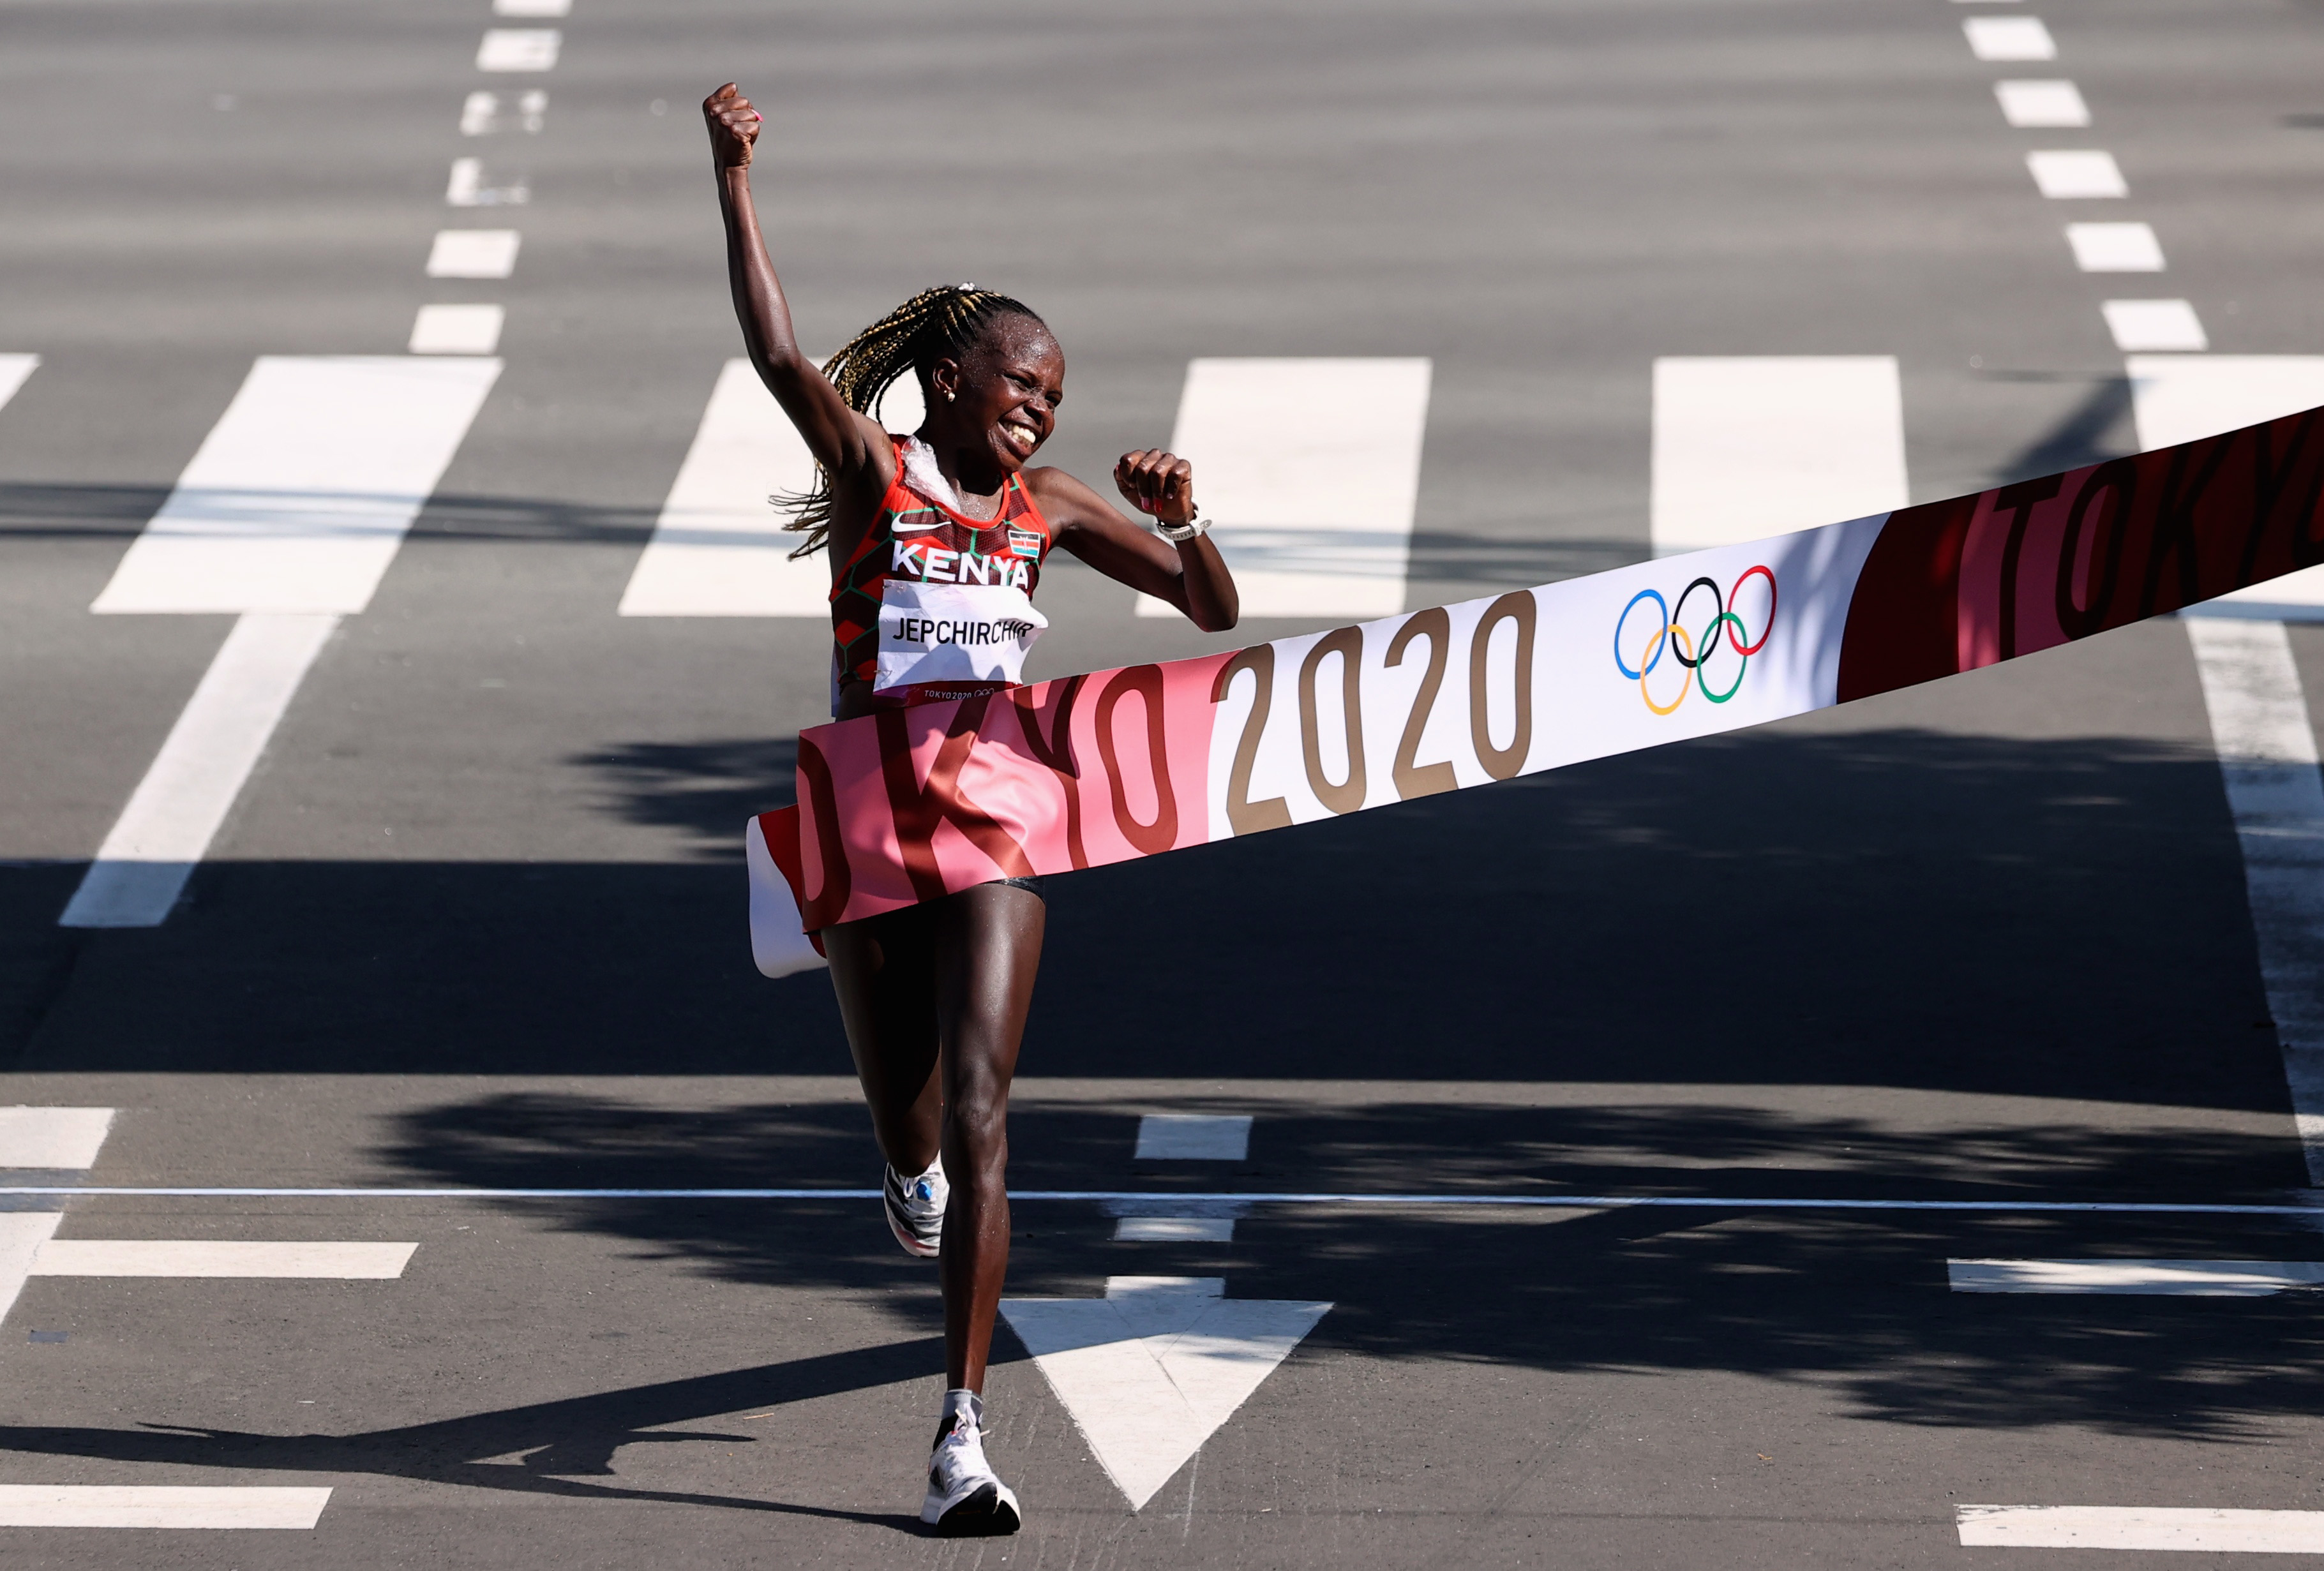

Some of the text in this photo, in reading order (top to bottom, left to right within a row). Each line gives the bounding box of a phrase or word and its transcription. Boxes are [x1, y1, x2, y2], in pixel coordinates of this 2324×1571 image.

[892, 540, 1028, 589] KENYA
[893, 618, 1034, 644] JEPCHIRCHIR
[924, 690, 951, 699] TOKYO
[1210, 589, 1536, 837] 2020
